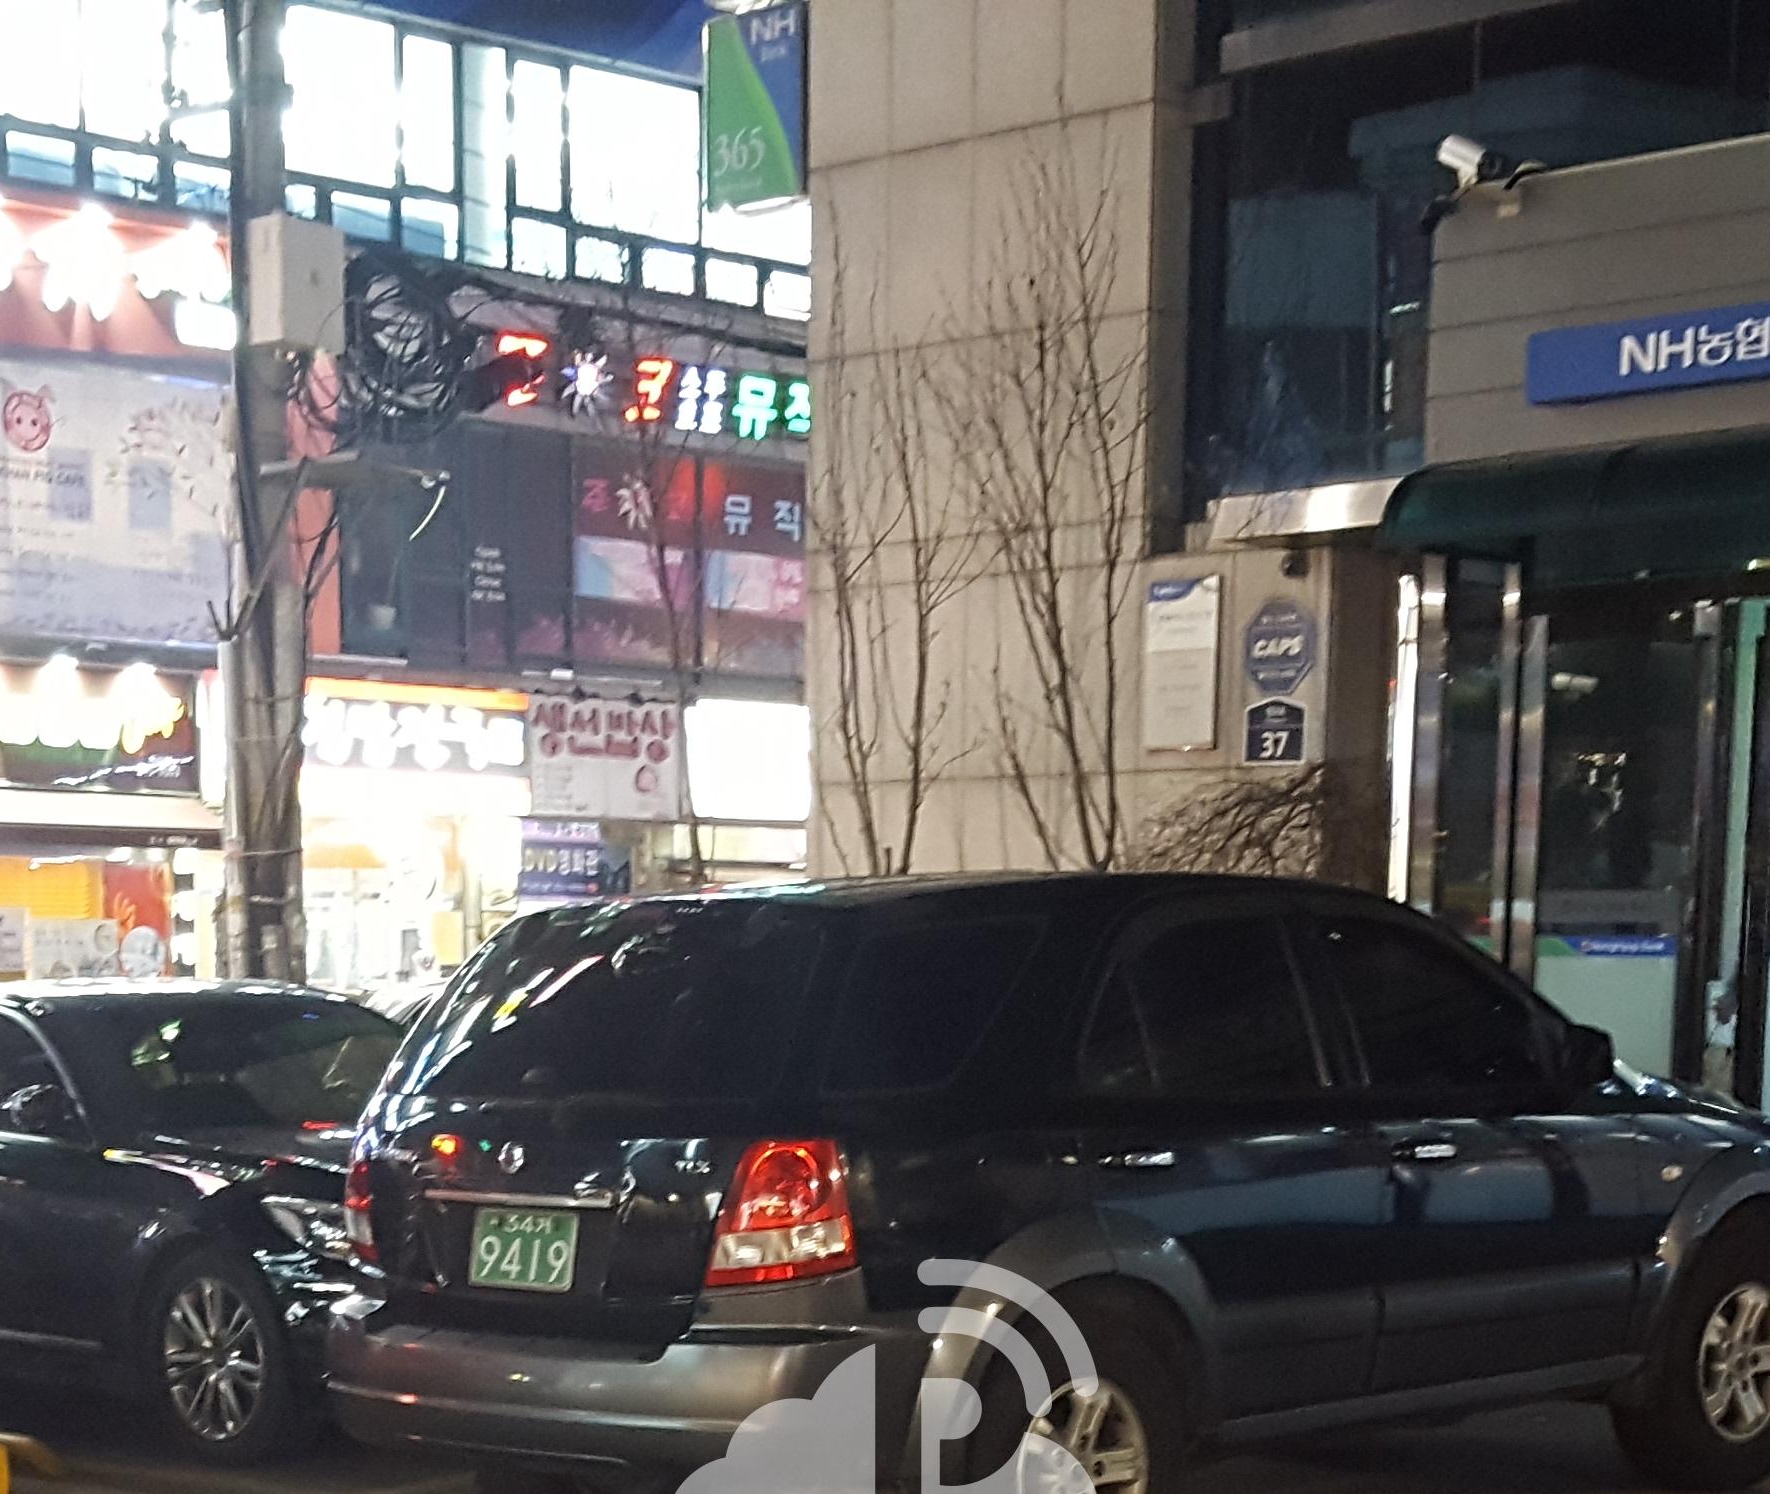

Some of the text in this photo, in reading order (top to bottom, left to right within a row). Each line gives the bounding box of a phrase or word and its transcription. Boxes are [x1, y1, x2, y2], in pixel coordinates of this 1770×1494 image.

[750, 9, 797, 45] NH
[713, 126, 766, 178] 365
[1252, 634, 1306, 660] CAPS
[1259, 730, 1290, 759] 37
[479, 1235, 569, 1284] 9419
